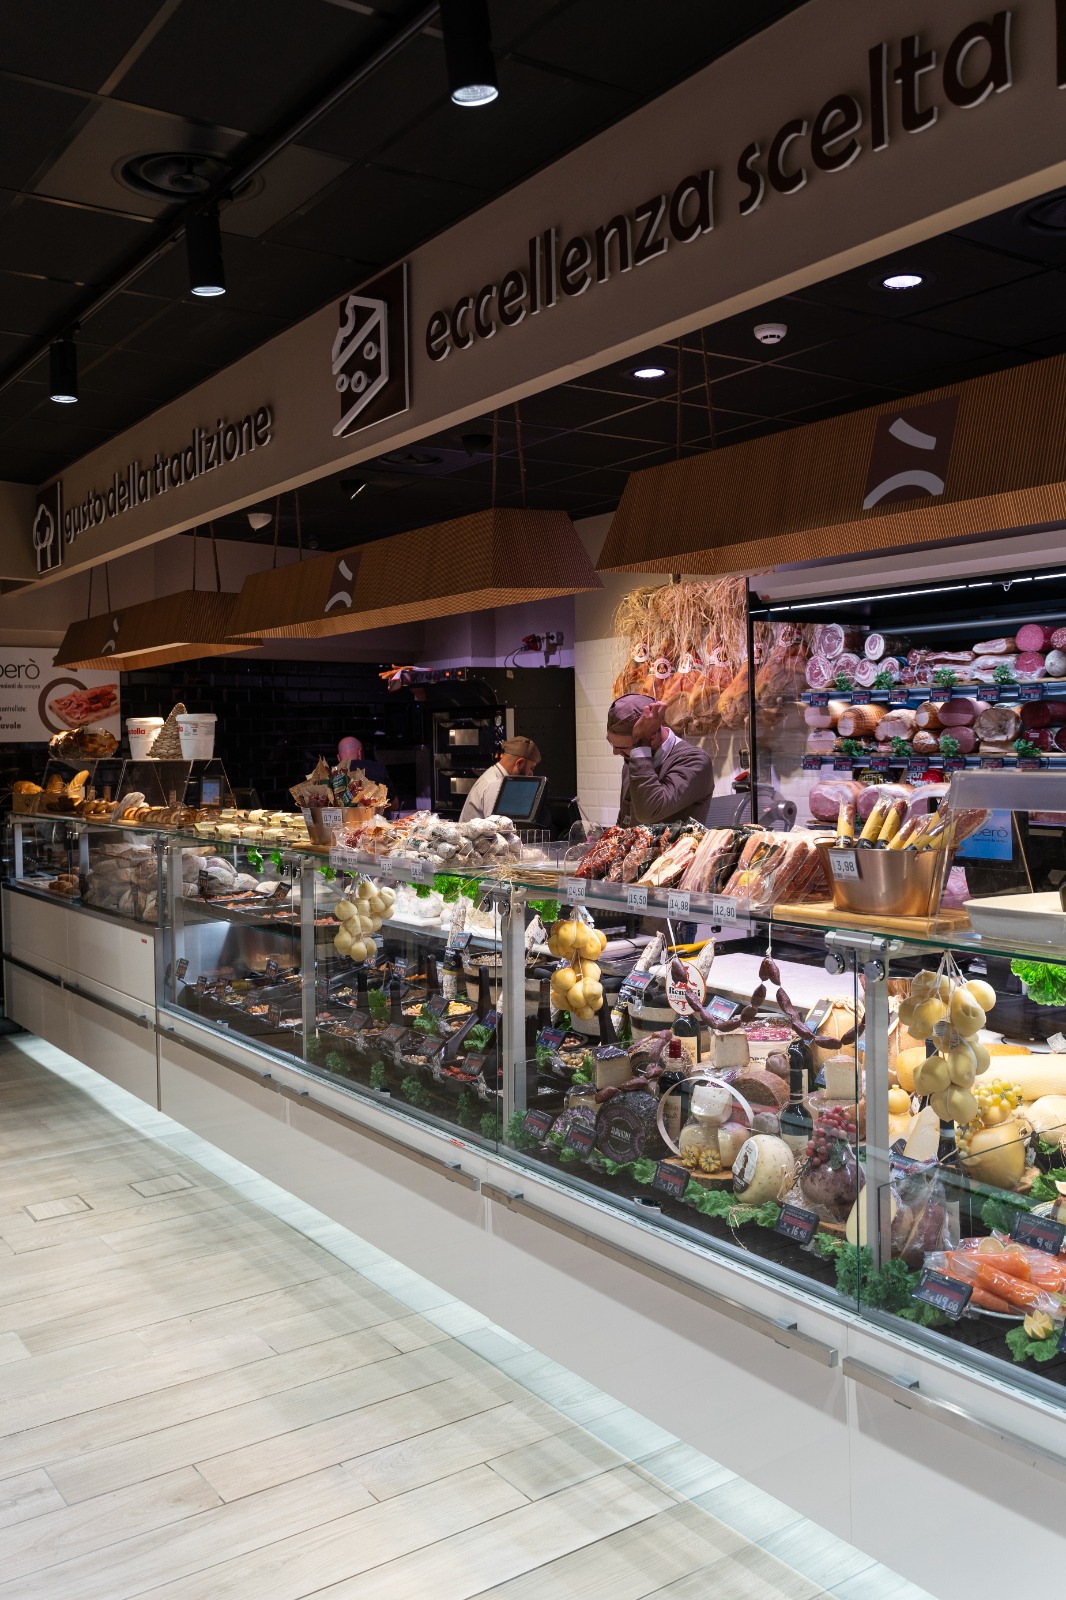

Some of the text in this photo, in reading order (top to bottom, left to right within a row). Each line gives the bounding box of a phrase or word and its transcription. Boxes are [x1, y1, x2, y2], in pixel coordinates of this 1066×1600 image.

[425, 168, 715, 362] eccellenza
[737, 10, 1012, 215] scelta
[64, 405, 272, 544] gusto della tradizione
[836, 860, 855, 873] 3,98
[630, 893, 647, 905] 15,50
[671, 899, 689, 911] 14,98
[716, 905, 735, 917] 12,90
